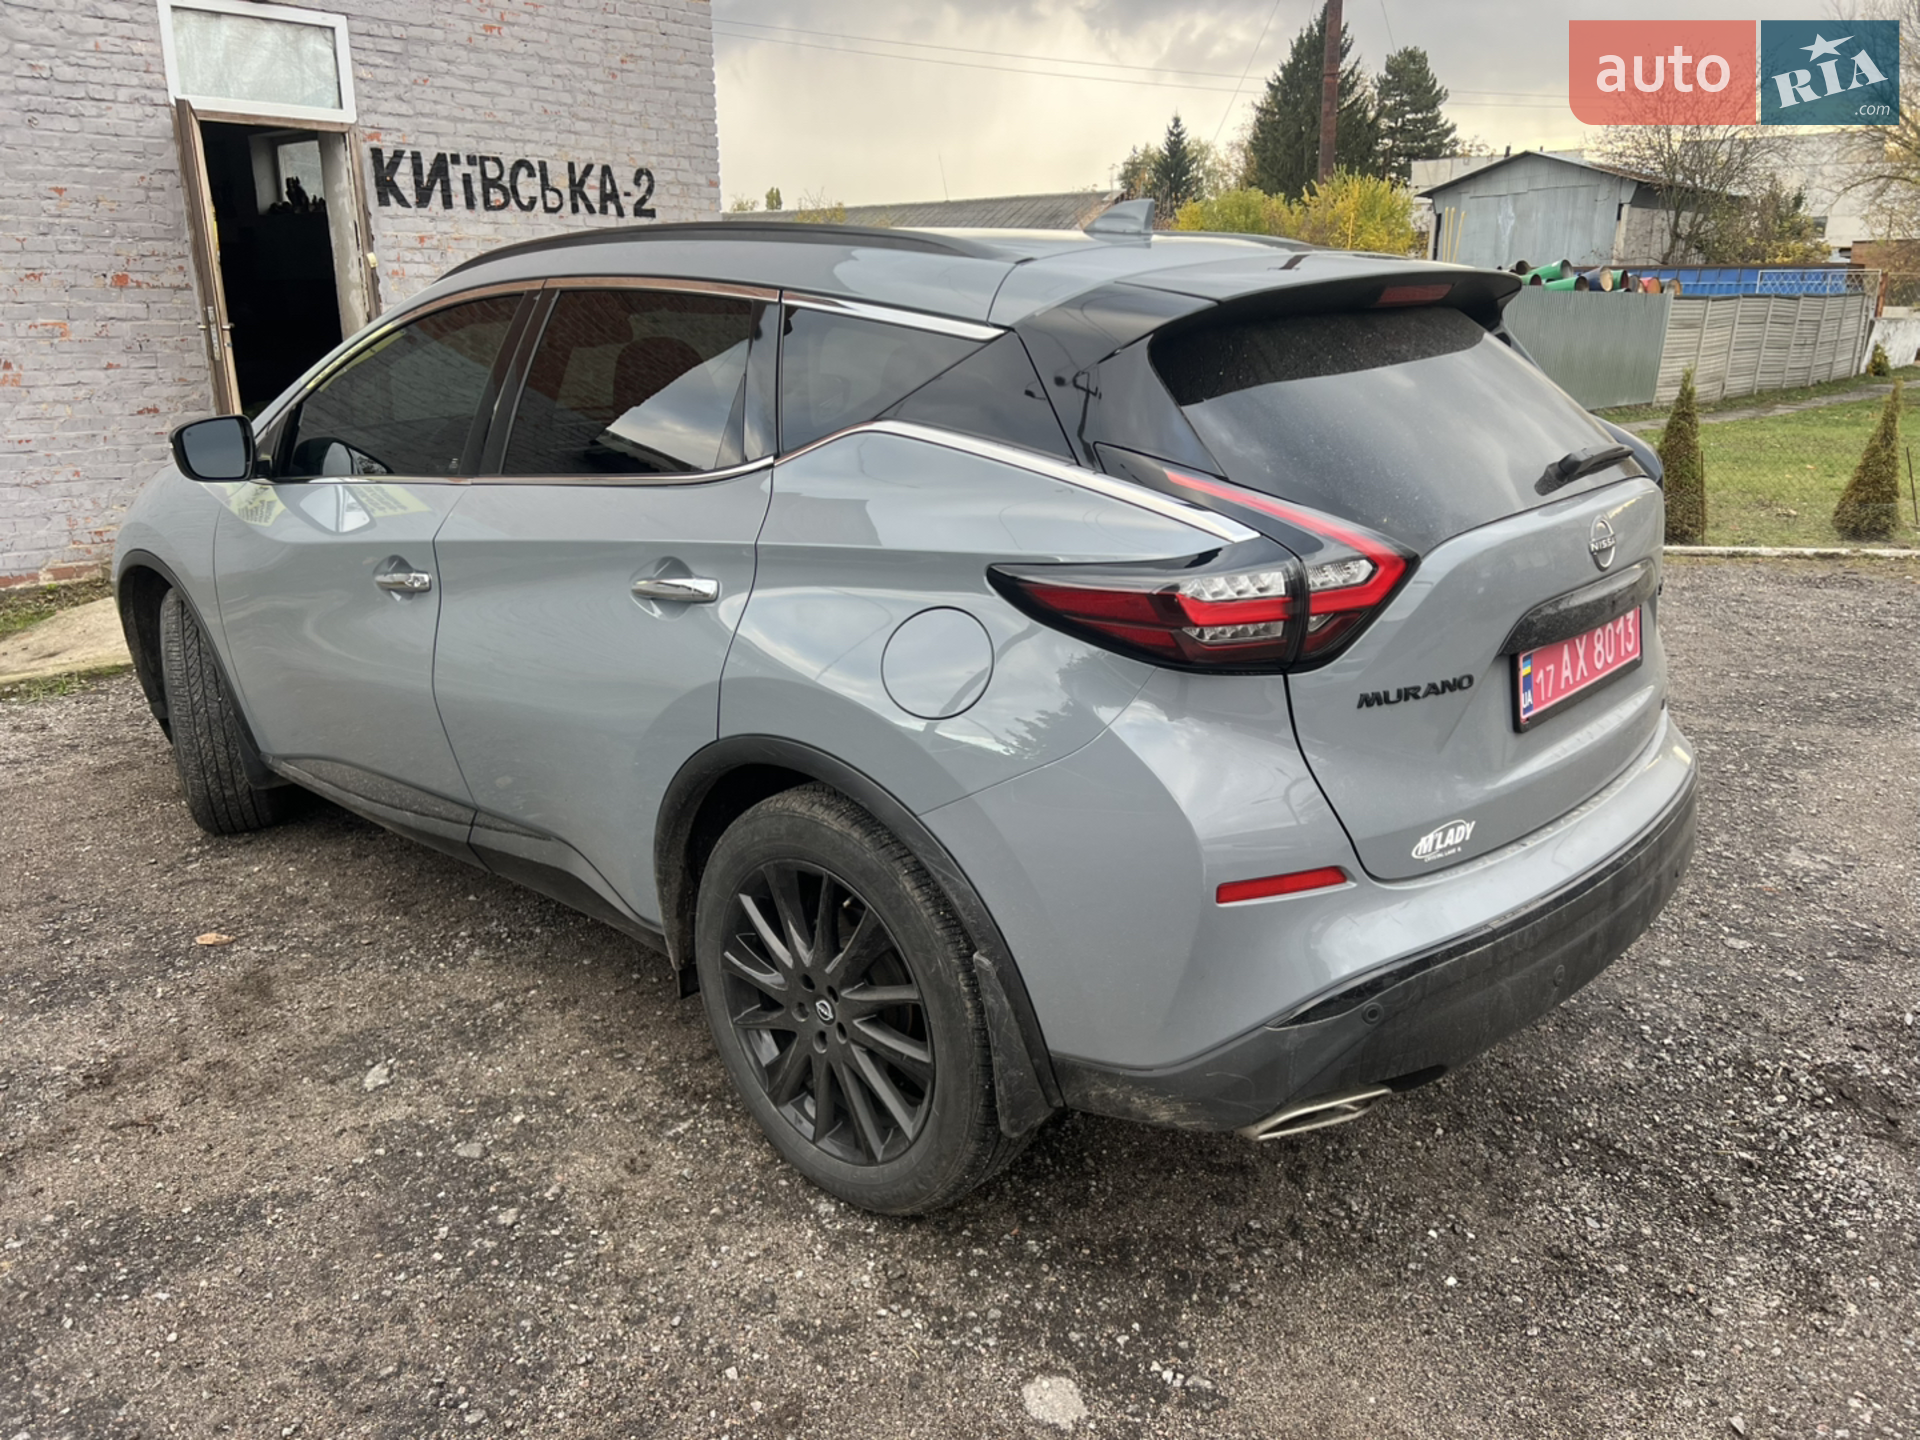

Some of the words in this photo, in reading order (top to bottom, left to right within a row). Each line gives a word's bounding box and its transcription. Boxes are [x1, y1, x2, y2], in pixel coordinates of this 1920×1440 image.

[370, 147, 657, 218] КИЇВСЬКА-2
[1536, 663, 1555, 701] 17
[1560, 634, 1588, 690] AX
[1593, 609, 1635, 671] 8013
[1356, 673, 1475, 709] MURANO
[1522, 689, 1533, 709] UA
[1417, 820, 1477, 856] M'LADY
